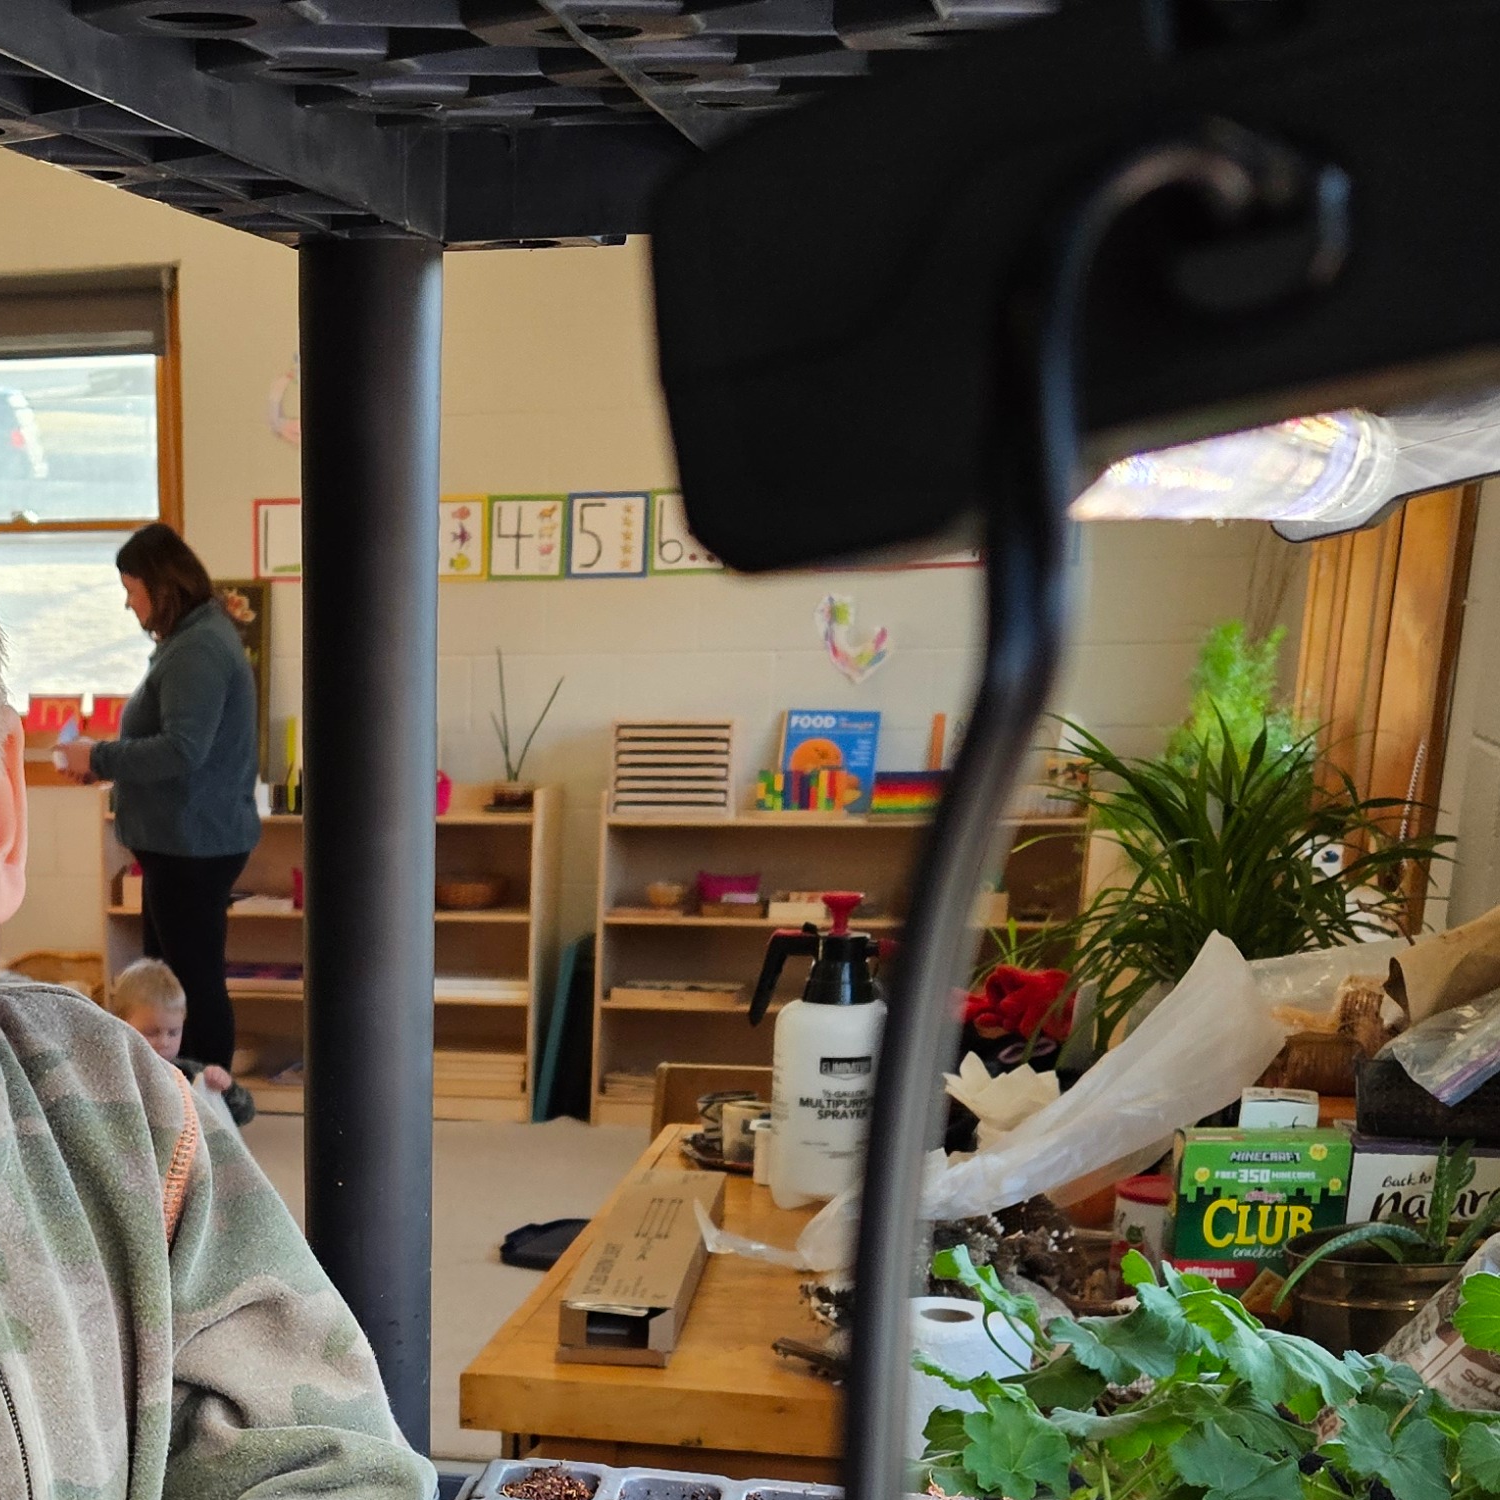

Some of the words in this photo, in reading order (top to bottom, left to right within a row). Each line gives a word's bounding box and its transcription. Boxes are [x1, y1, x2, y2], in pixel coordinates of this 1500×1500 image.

[496, 506, 534, 569] 4
[579, 502, 607, 568] 5
[790, 715, 837, 729] FOOD
[1230, 1151, 1301, 1163] MINECRAFT
[1238, 1169, 1271, 1183] 350
[1381, 1172, 1417, 1188] Back
[1418, 1171, 1433, 1184] to
